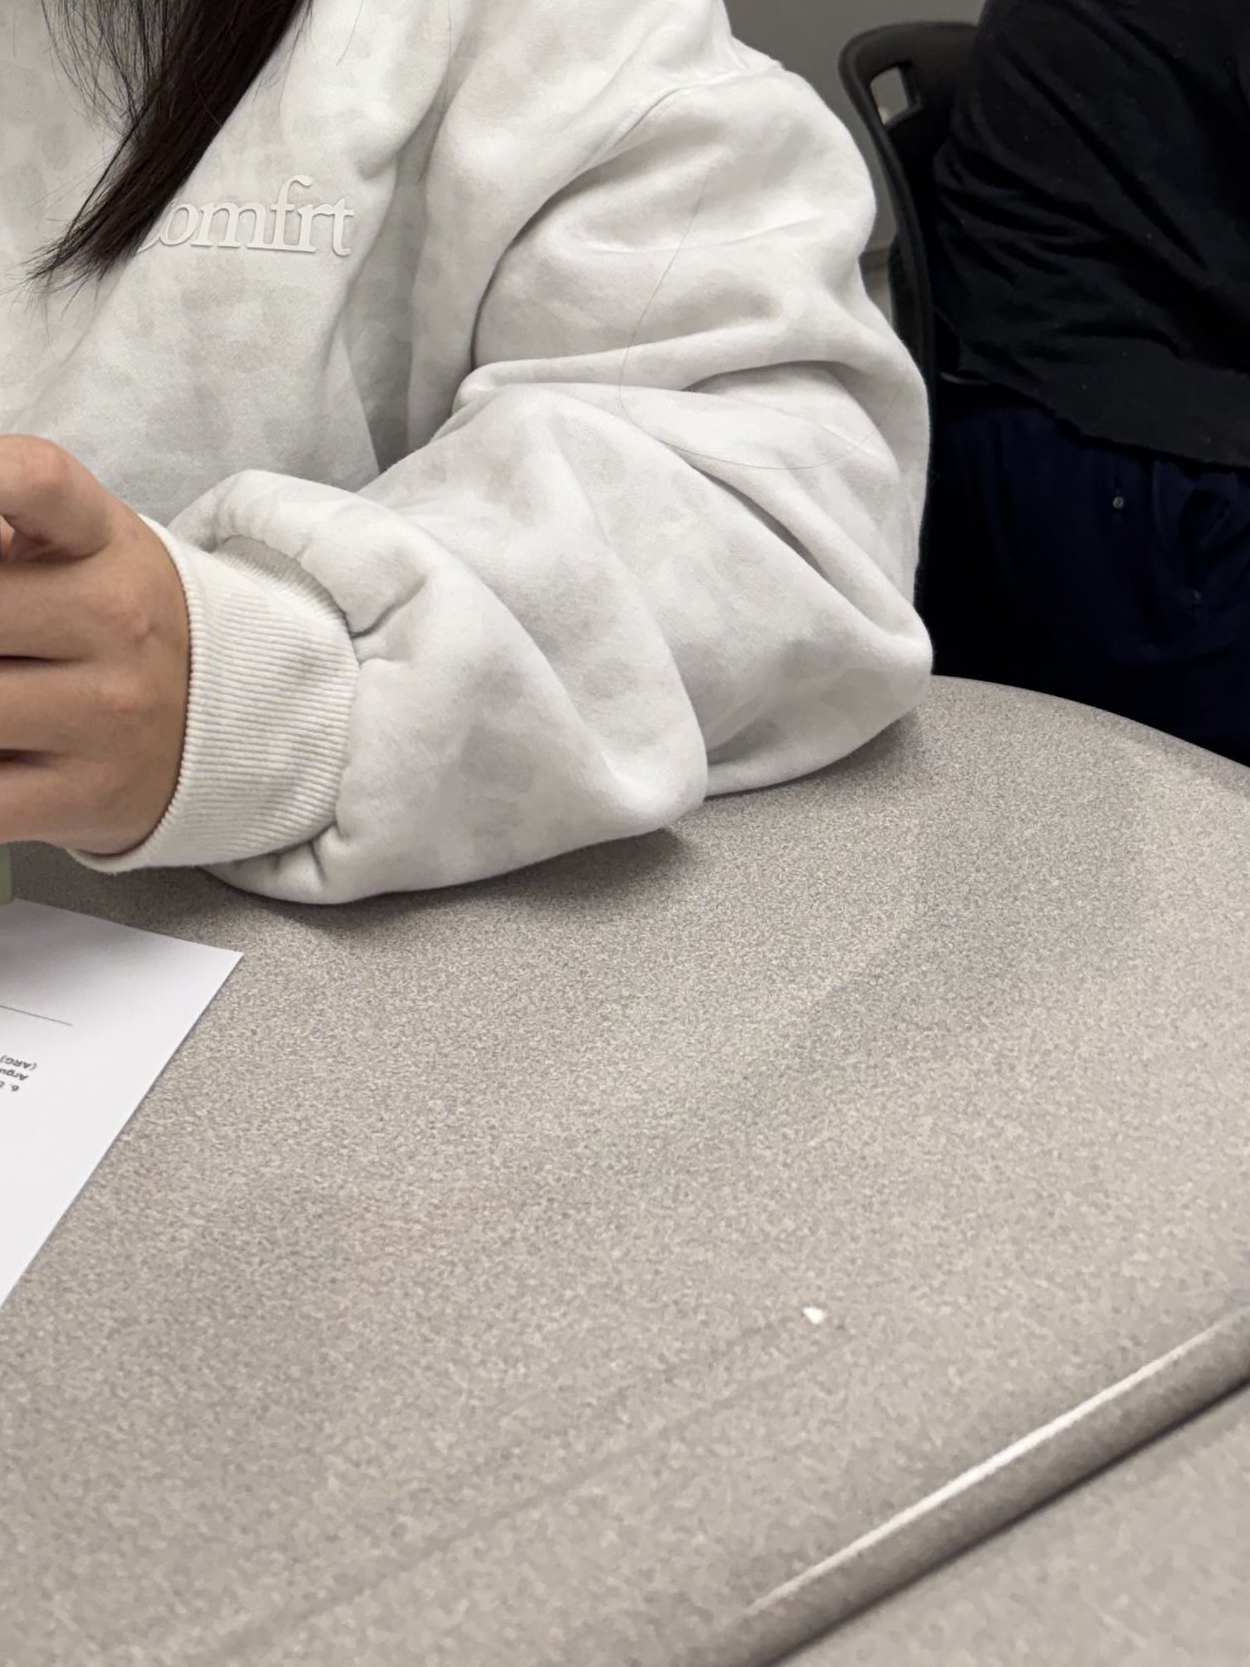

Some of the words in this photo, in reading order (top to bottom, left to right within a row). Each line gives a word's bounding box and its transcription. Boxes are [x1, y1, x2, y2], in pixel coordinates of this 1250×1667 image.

[134, 175, 355, 257] omfrt
[0, 1055, 37, 1071] (ARG)
[9, 1083, 20, 1092] 6.
